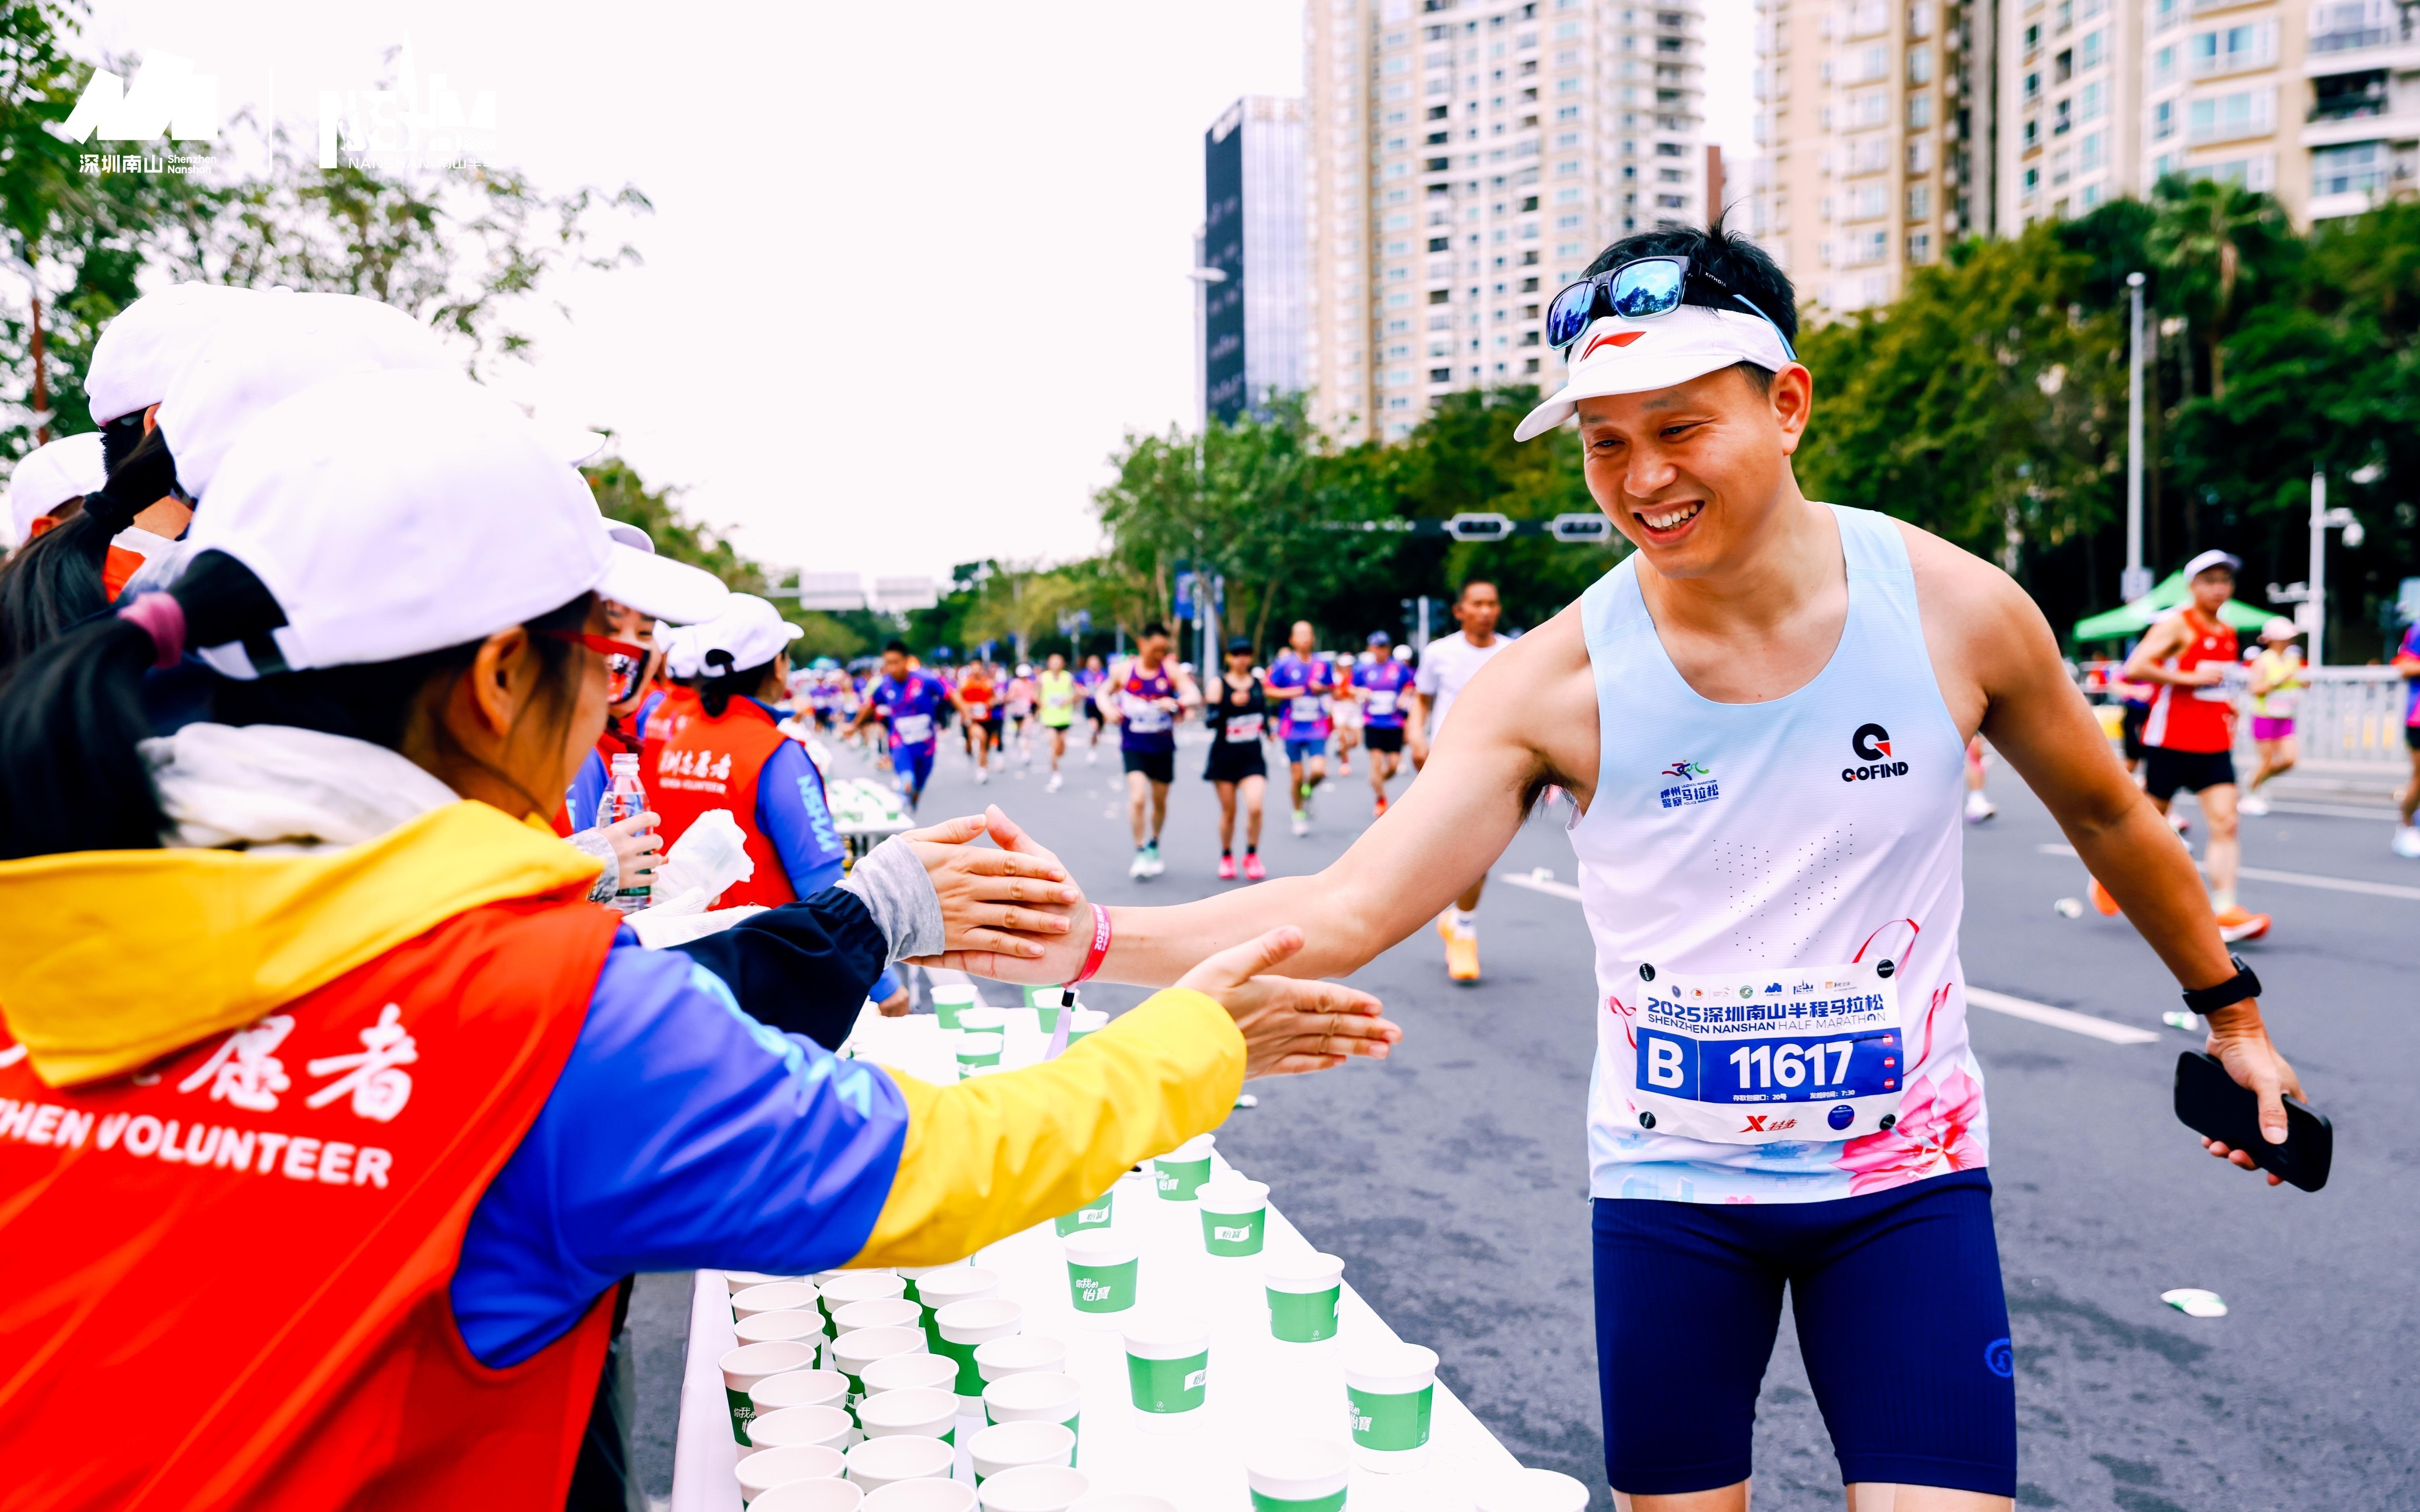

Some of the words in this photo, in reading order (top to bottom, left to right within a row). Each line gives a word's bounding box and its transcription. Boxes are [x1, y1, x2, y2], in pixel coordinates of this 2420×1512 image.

[1681, 784, 1719, 800] 马拉松
[1648, 994, 1884, 1023] 2025深圳南山半程马拉松
[1648, 1014, 1709, 1033] SHENZHEN
[1713, 1022, 1775, 1033] NANSHAN
[1779, 1020, 1814, 1030] HALF
[1816, 1012, 1885, 1029] MARATHON
[131, 1002, 419, 1122] 愿者
[1648, 1037, 1684, 1088] B
[1730, 1040, 1853, 1088] 11617
[0, 1098, 96, 1149] HEN
[96, 1112, 393, 1189] VOLUNTEER
[1076, 1278, 1099, 1288] 你我的
[1083, 1286, 1111, 1301] 怡寶
[846, 1394, 855, 1405] 寶
